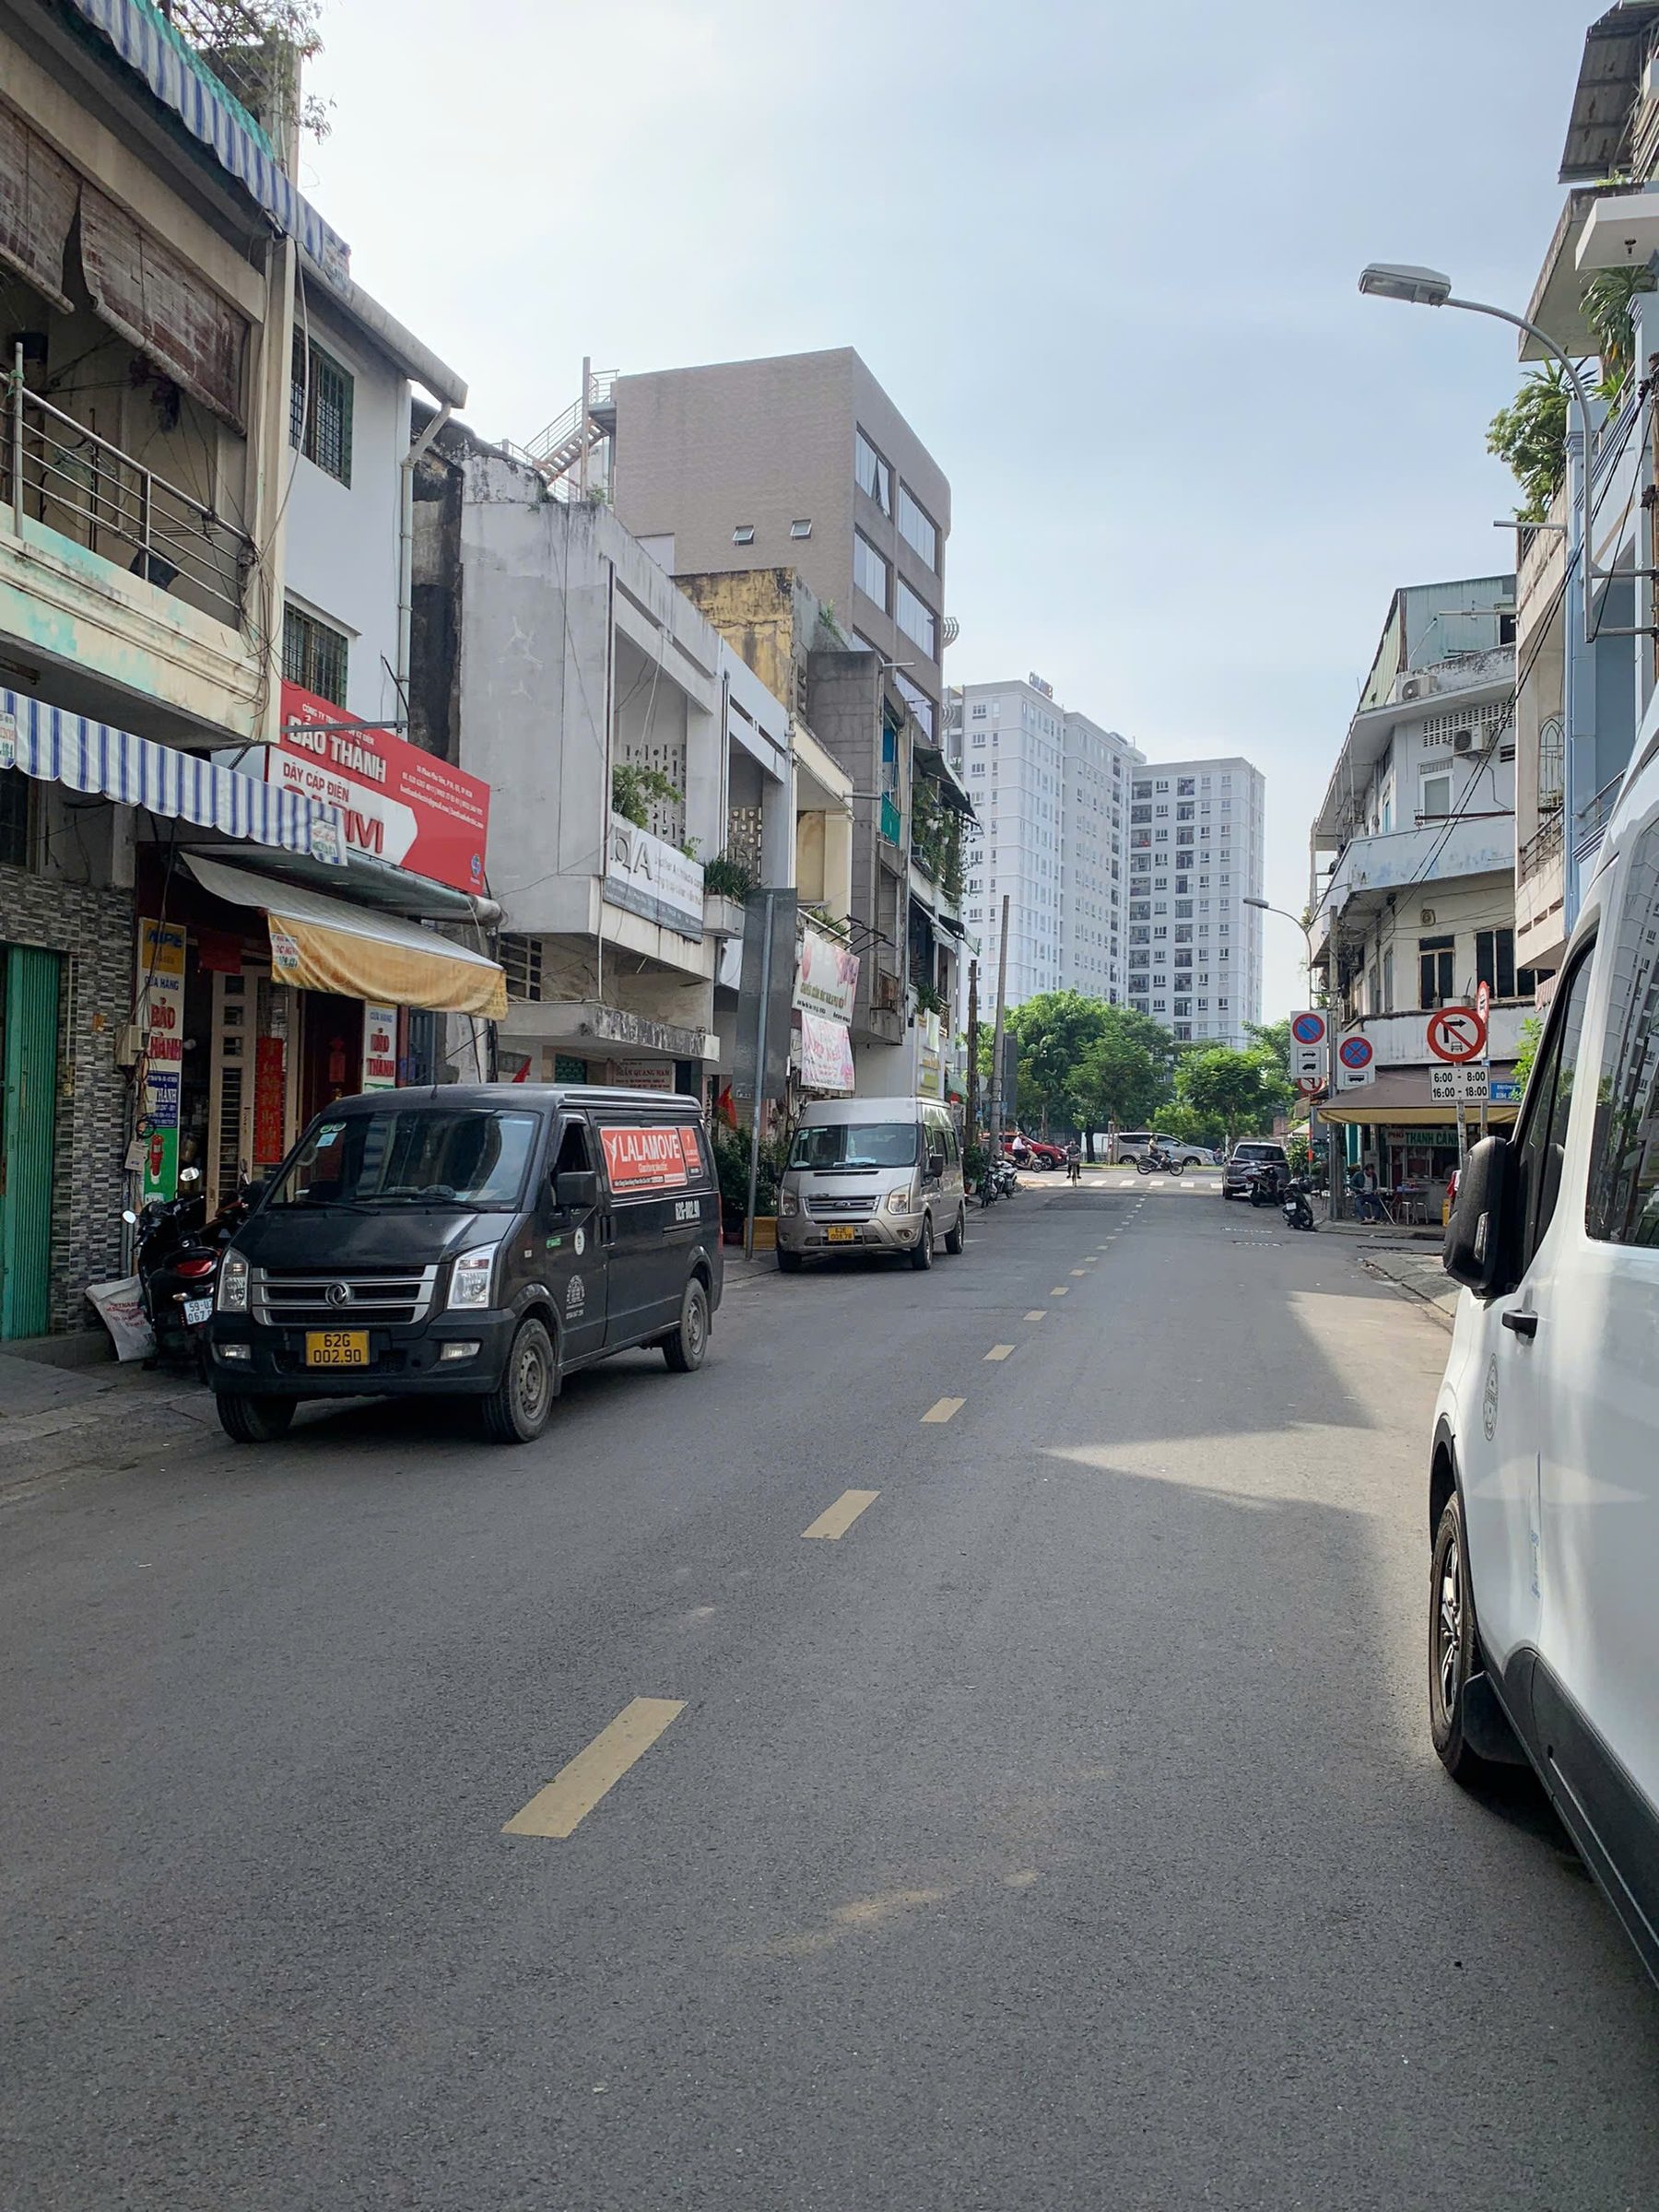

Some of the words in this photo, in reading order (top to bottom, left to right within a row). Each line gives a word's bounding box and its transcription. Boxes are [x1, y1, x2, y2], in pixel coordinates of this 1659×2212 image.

[329, 735, 386, 783] THÀNH
[283, 761, 303, 783] DÂY
[306, 771, 325, 791] CÁP
[327, 782, 349, 802] ĐIỆN
[1434, 1072, 1453, 1083] 6:00
[1467, 1071, 1486, 1082] 8:00
[1433, 1088, 1455, 1098] 16:00
[1465, 1086, 1488, 1097] 18:00
[618, 1135, 680, 1162] LALAMOVE
[324, 1334, 350, 1347] 62G
[314, 1349, 361, 1363] 002.90
